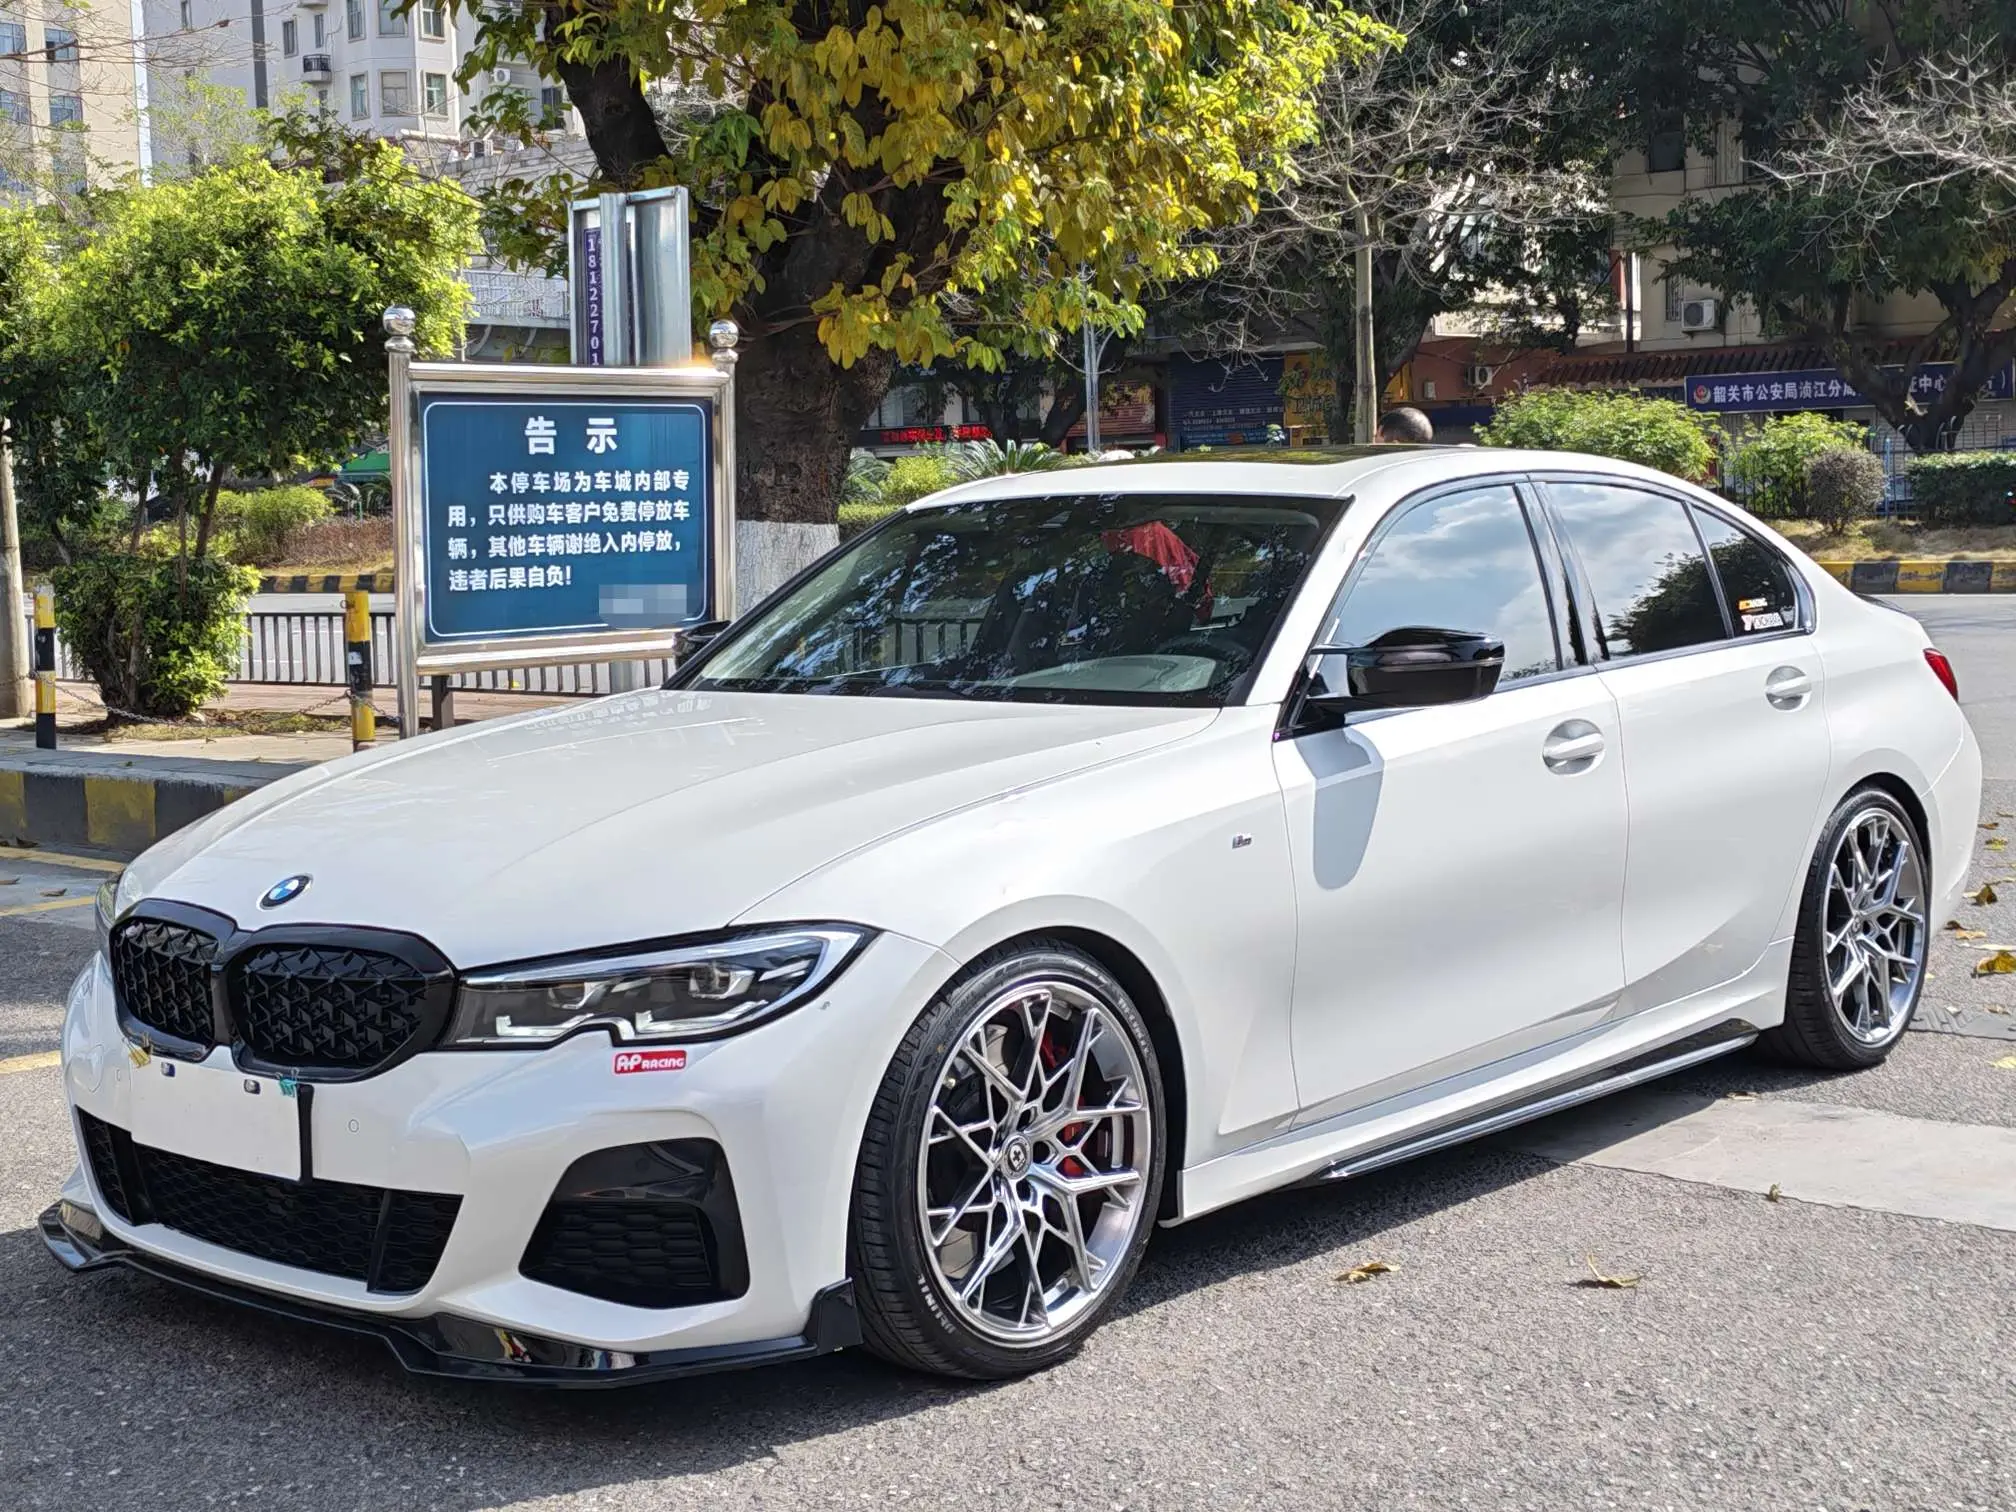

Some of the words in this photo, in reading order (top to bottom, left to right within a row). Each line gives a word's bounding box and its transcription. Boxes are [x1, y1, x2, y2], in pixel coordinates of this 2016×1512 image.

[587, 238, 600, 366] 18122701
[524, 415, 618, 455] 告示
[489, 469, 690, 494] 本停车场为车城内部专
[448, 499, 690, 527] 用，只供购车客户免费停放车
[448, 530, 682, 560] 辆，其他车辆谢绝入内停放，
[449, 565, 572, 592] 违者后果自负！
[641, 1057, 685, 1070] RACING
